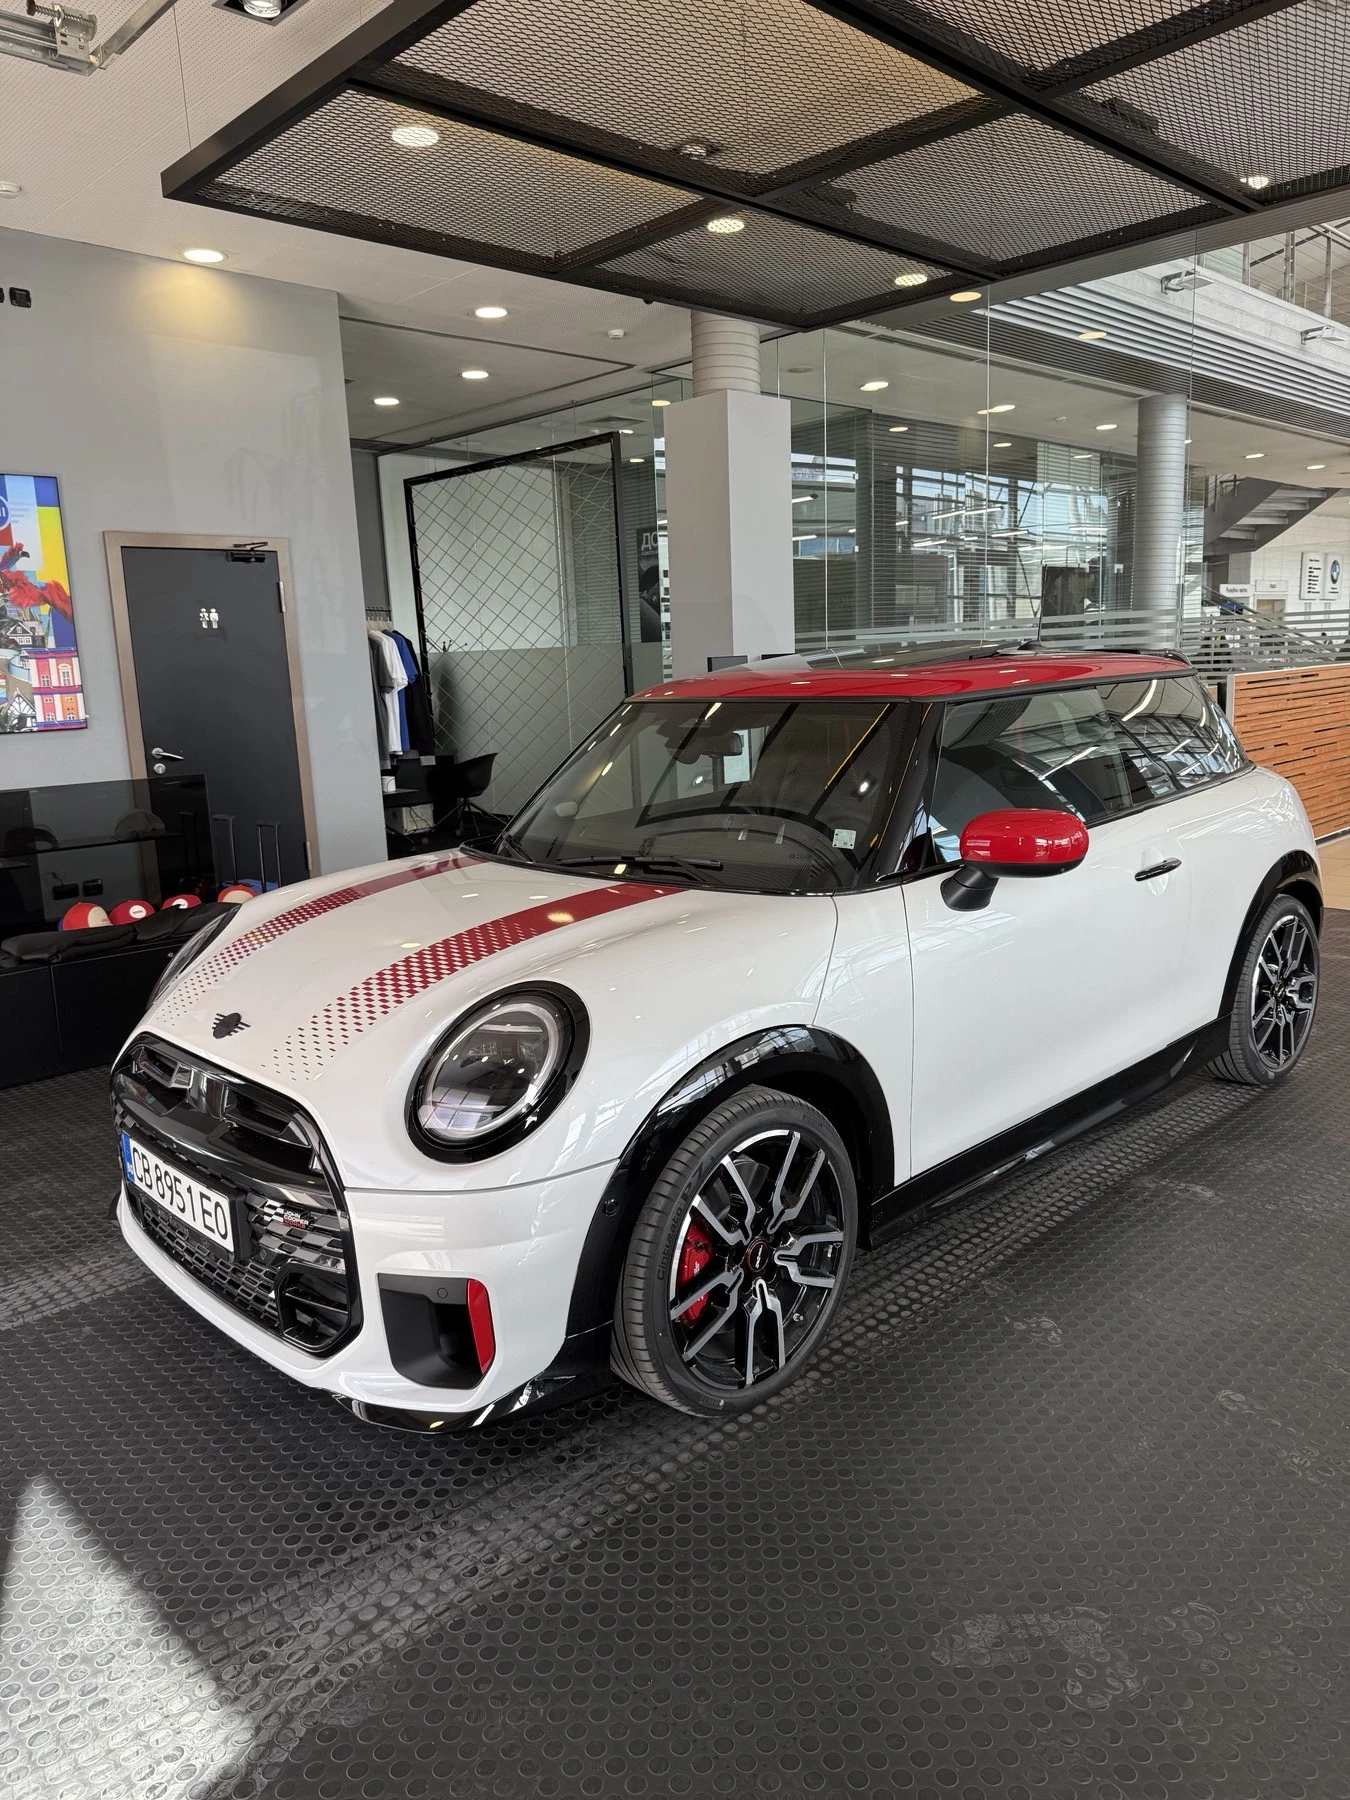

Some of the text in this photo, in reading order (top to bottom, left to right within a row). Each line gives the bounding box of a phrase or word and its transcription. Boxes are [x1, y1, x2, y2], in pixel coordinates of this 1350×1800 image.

[155, 1163, 196, 1222] 8951
[284, 1215, 309, 1226] COOPER
[657, 1207, 682, 1280] Cinturato
